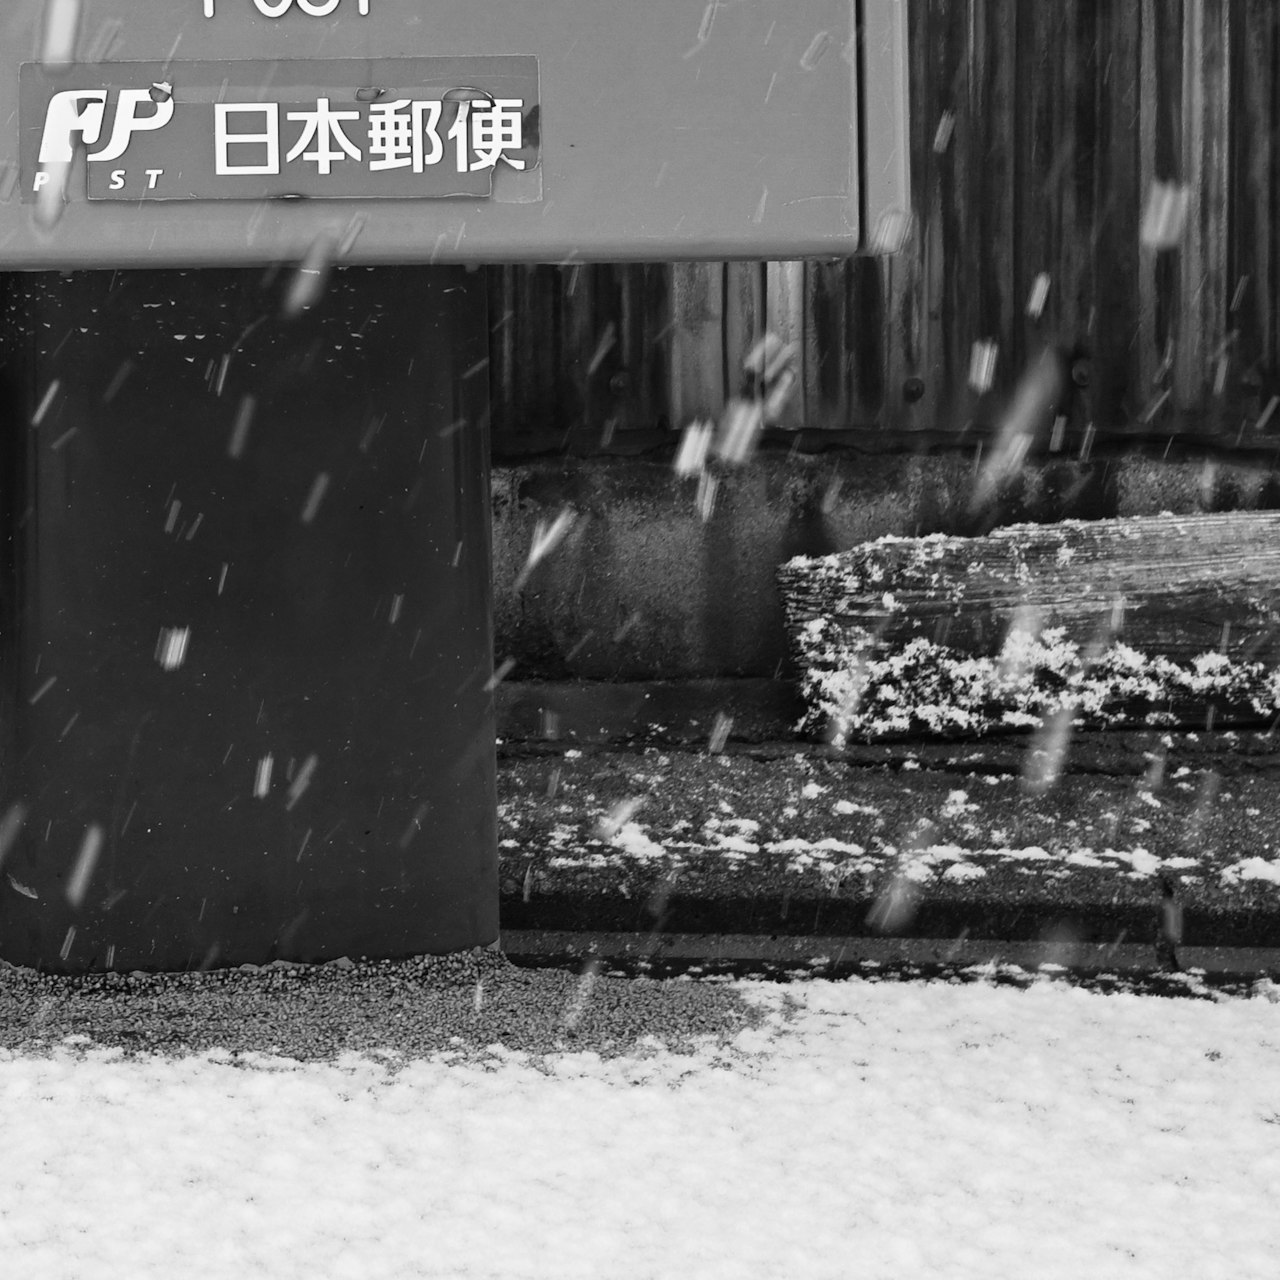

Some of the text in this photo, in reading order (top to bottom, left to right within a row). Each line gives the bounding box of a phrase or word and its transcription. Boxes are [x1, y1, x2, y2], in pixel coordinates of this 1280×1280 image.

[214, 97, 525, 176] 日本郵便
[33, 168, 163, 192] PST
